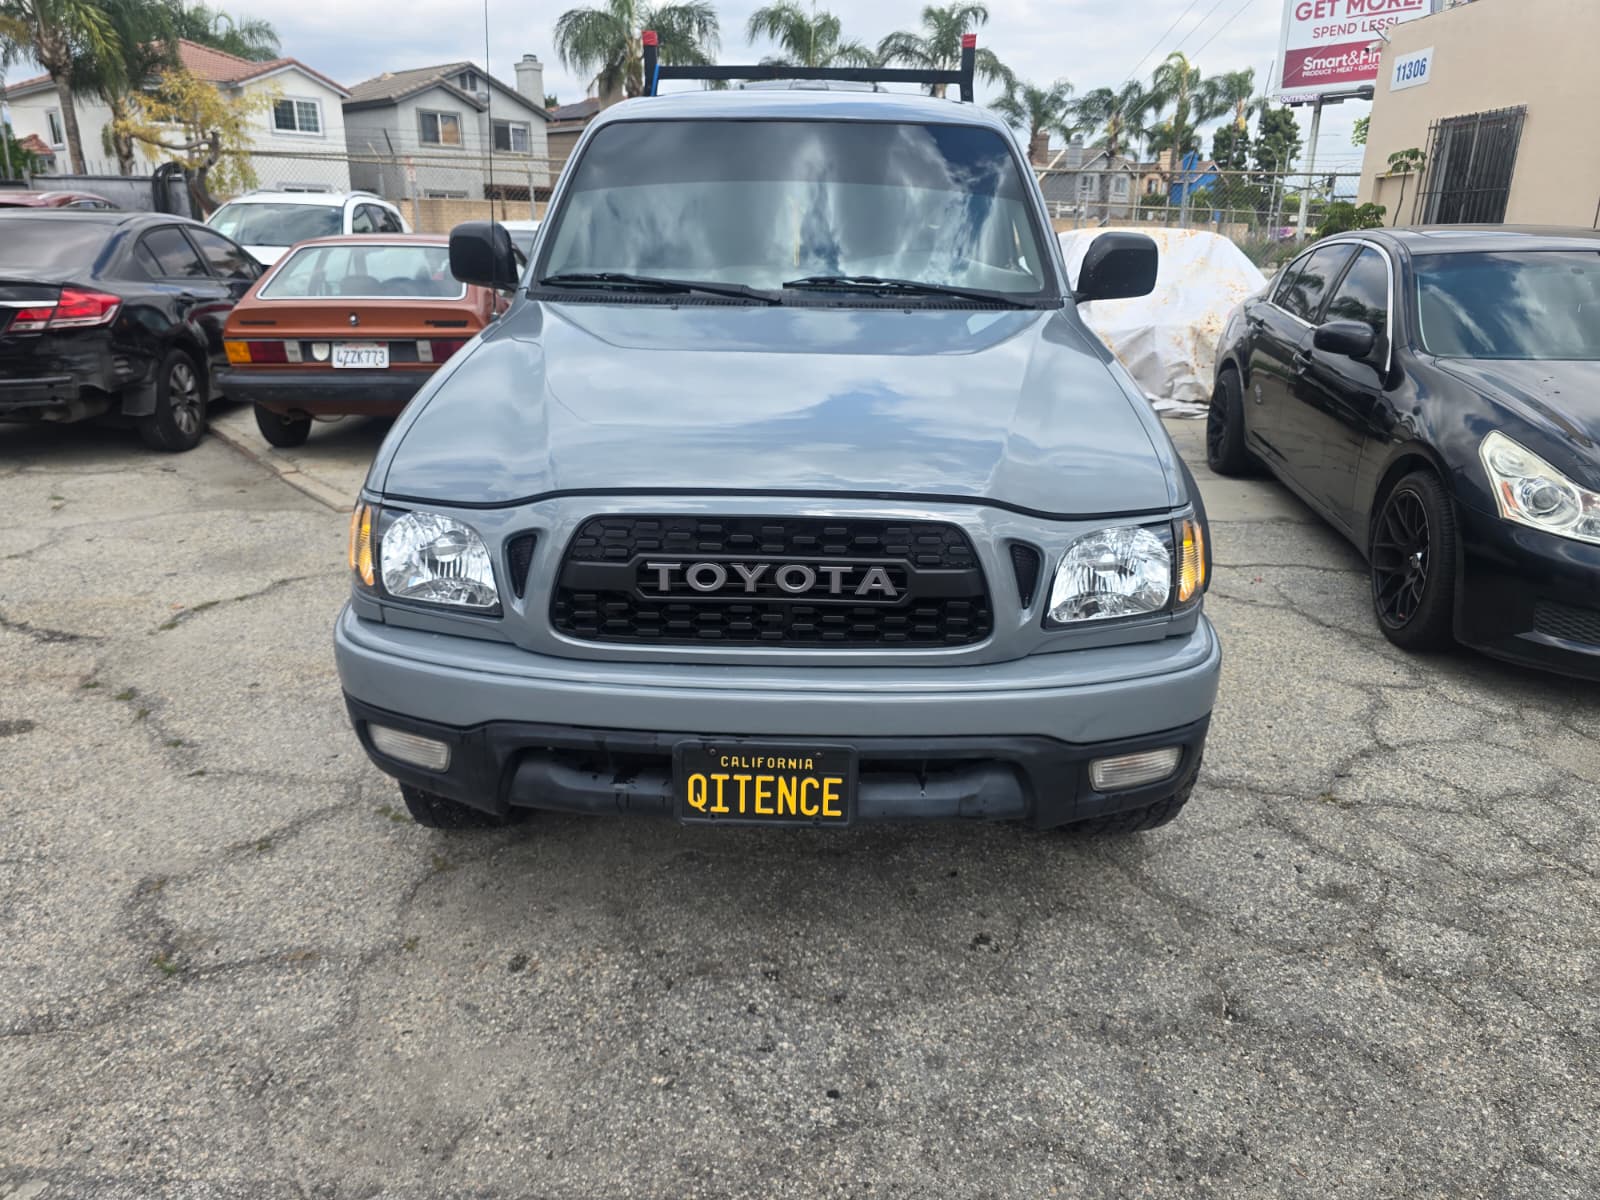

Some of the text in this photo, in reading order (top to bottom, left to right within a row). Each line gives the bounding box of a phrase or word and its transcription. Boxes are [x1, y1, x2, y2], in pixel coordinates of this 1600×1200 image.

[1295, 0, 1424, 21] GET MOR
[1312, 23, 1358, 39] SPEND
[1302, 69, 1332, 77] PRODUCE
[1336, 66, 1354, 74] MEAT
[1396, 57, 1427, 82] 11306
[647, 562, 898, 596] TOYOTA
[720, 755, 814, 770] CALIFORNIA
[687, 773, 843, 817] QITENCE
